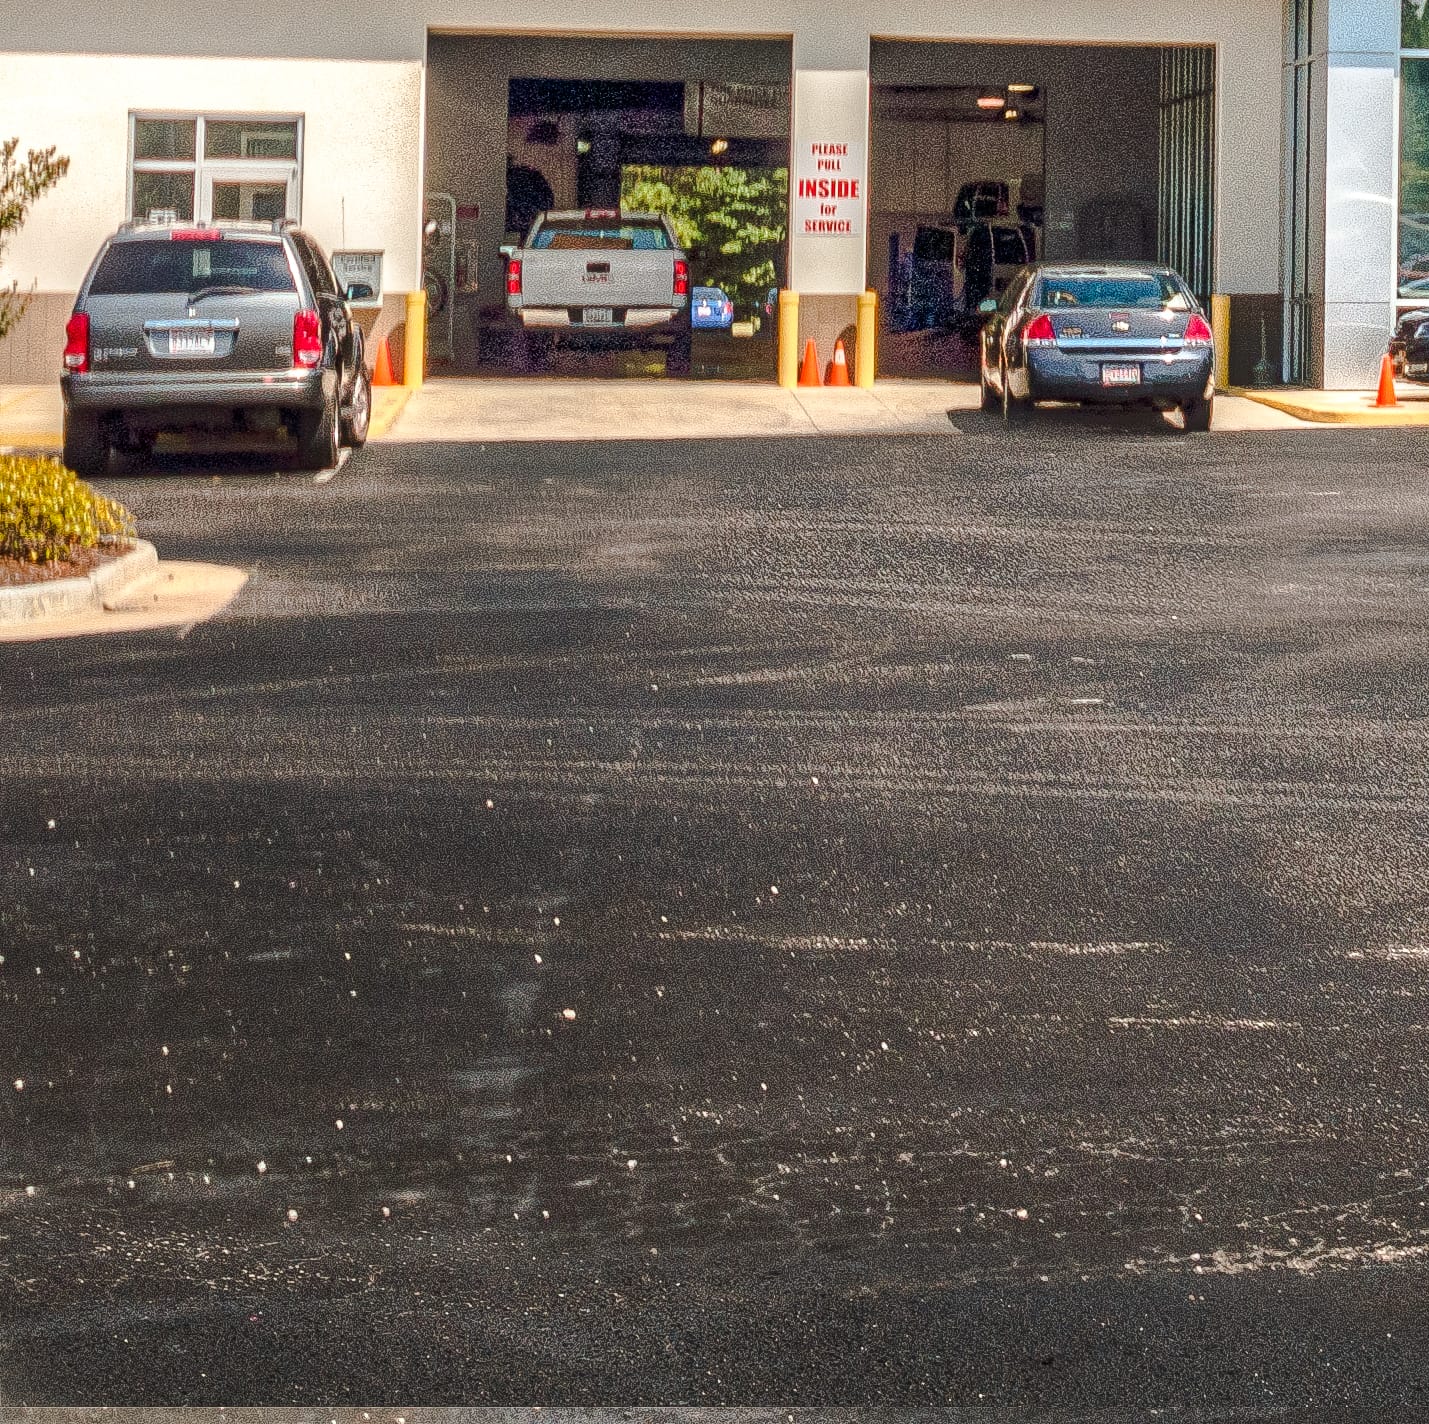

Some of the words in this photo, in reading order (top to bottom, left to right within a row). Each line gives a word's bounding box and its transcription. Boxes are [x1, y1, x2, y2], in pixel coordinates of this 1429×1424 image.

[811, 143, 848, 155] PLEASE
[817, 159, 841, 171] PULL
[798, 178, 860, 198] INSIDE
[820, 203, 837, 215] for
[804, 219, 851, 233] SERVICE
